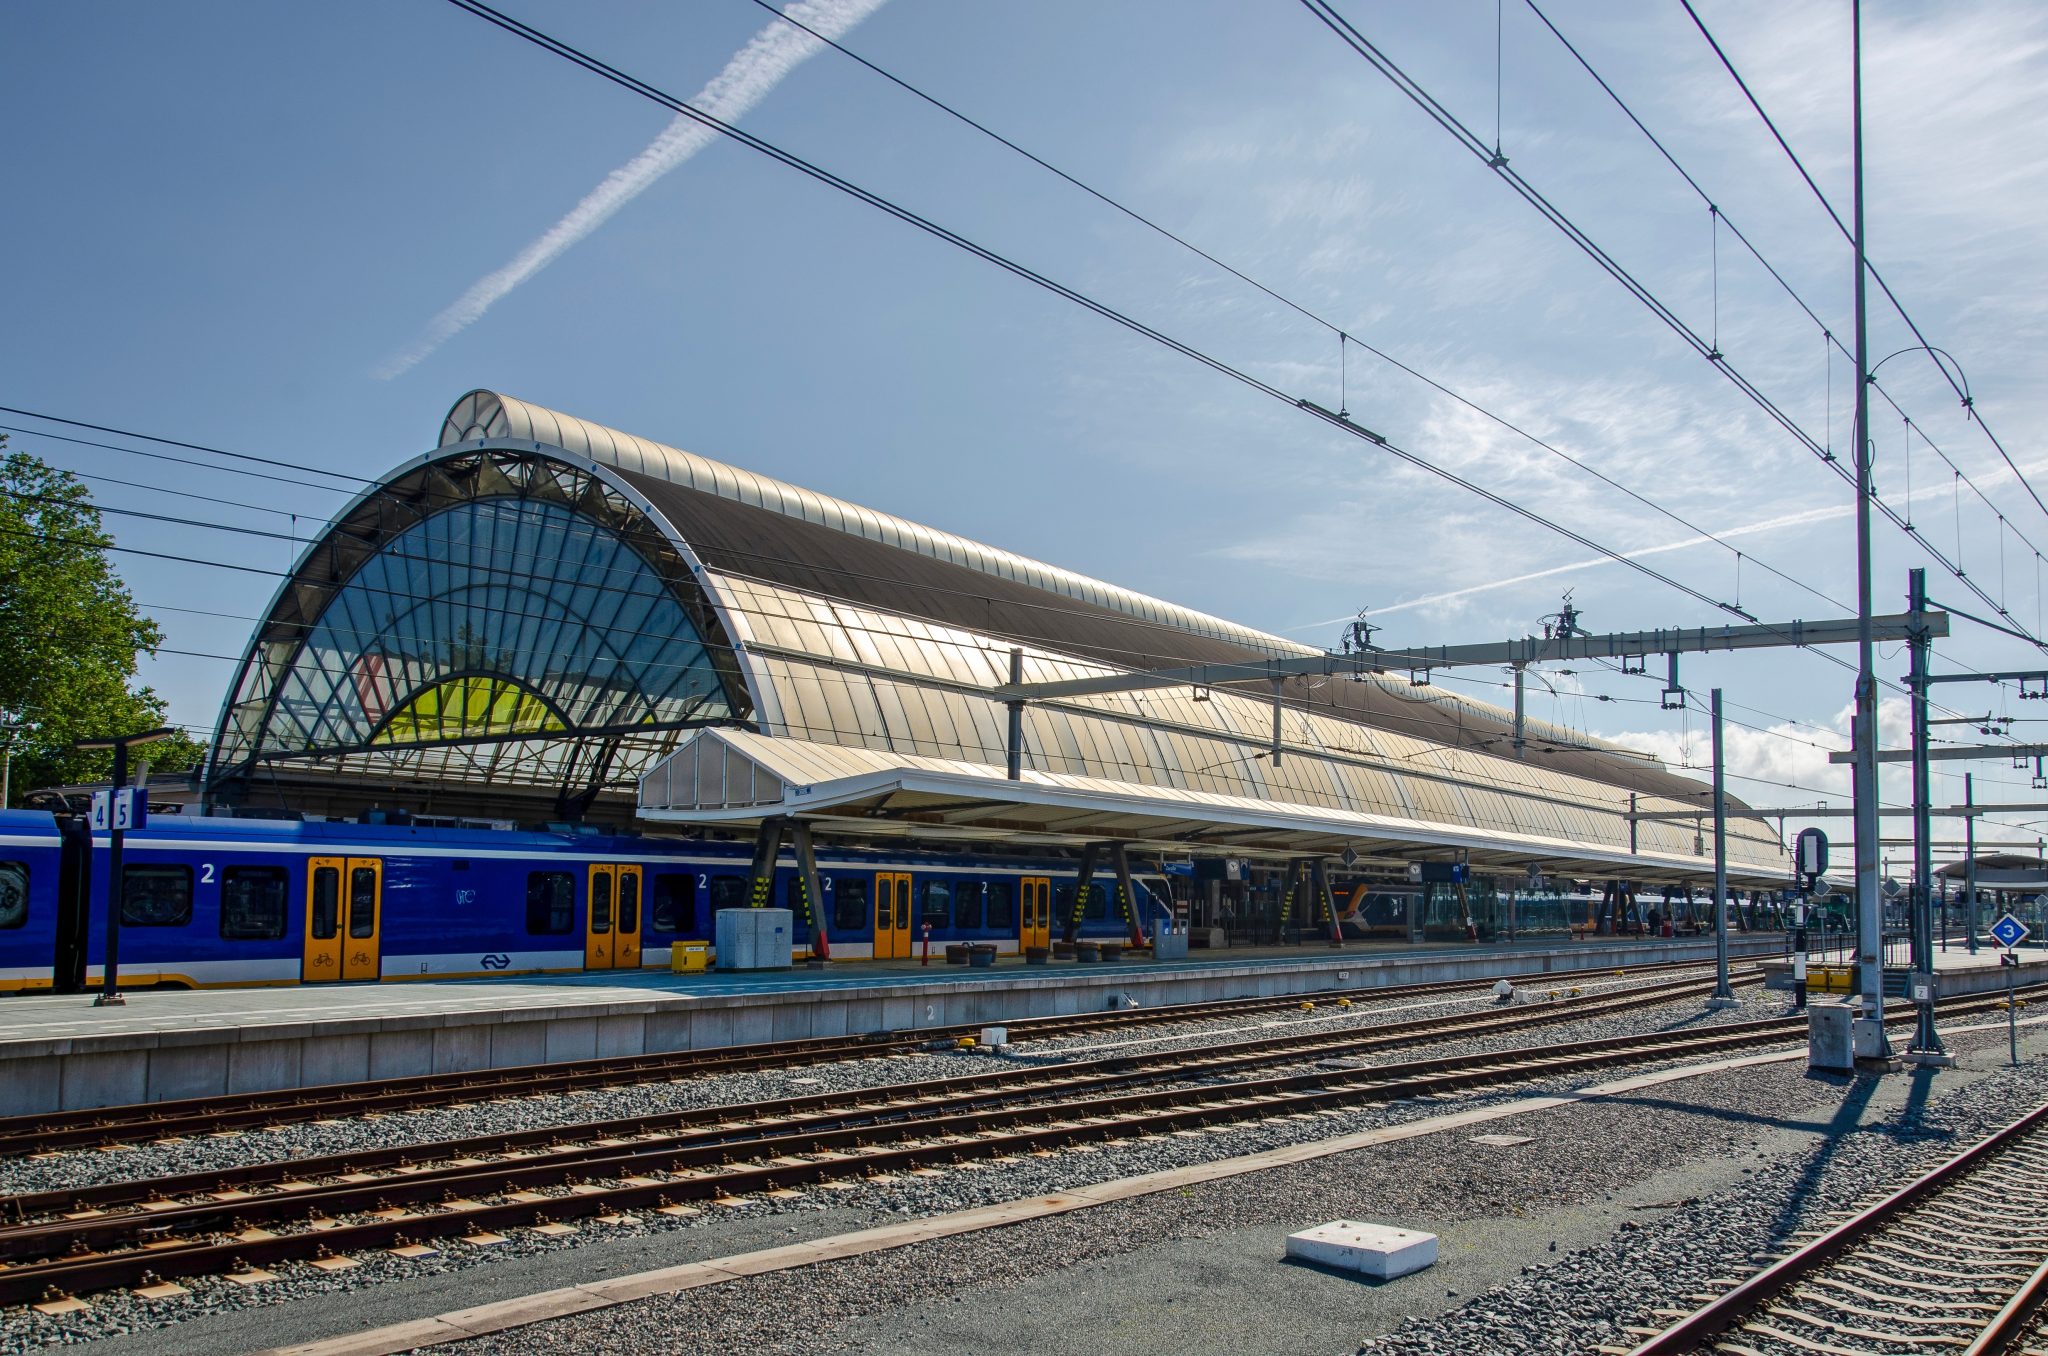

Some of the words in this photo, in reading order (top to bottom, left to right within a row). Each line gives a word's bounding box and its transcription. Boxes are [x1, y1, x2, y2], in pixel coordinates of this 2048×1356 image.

[96, 805, 104, 826] 4
[119, 804, 126, 825] 5
[201, 863, 215, 883] 2
[698, 873, 707, 889] 2
[824, 877, 832, 891] 2
[982, 881, 988, 894] 2
[2003, 925, 2014, 938] 3
[927, 1005, 935, 1021] 2
